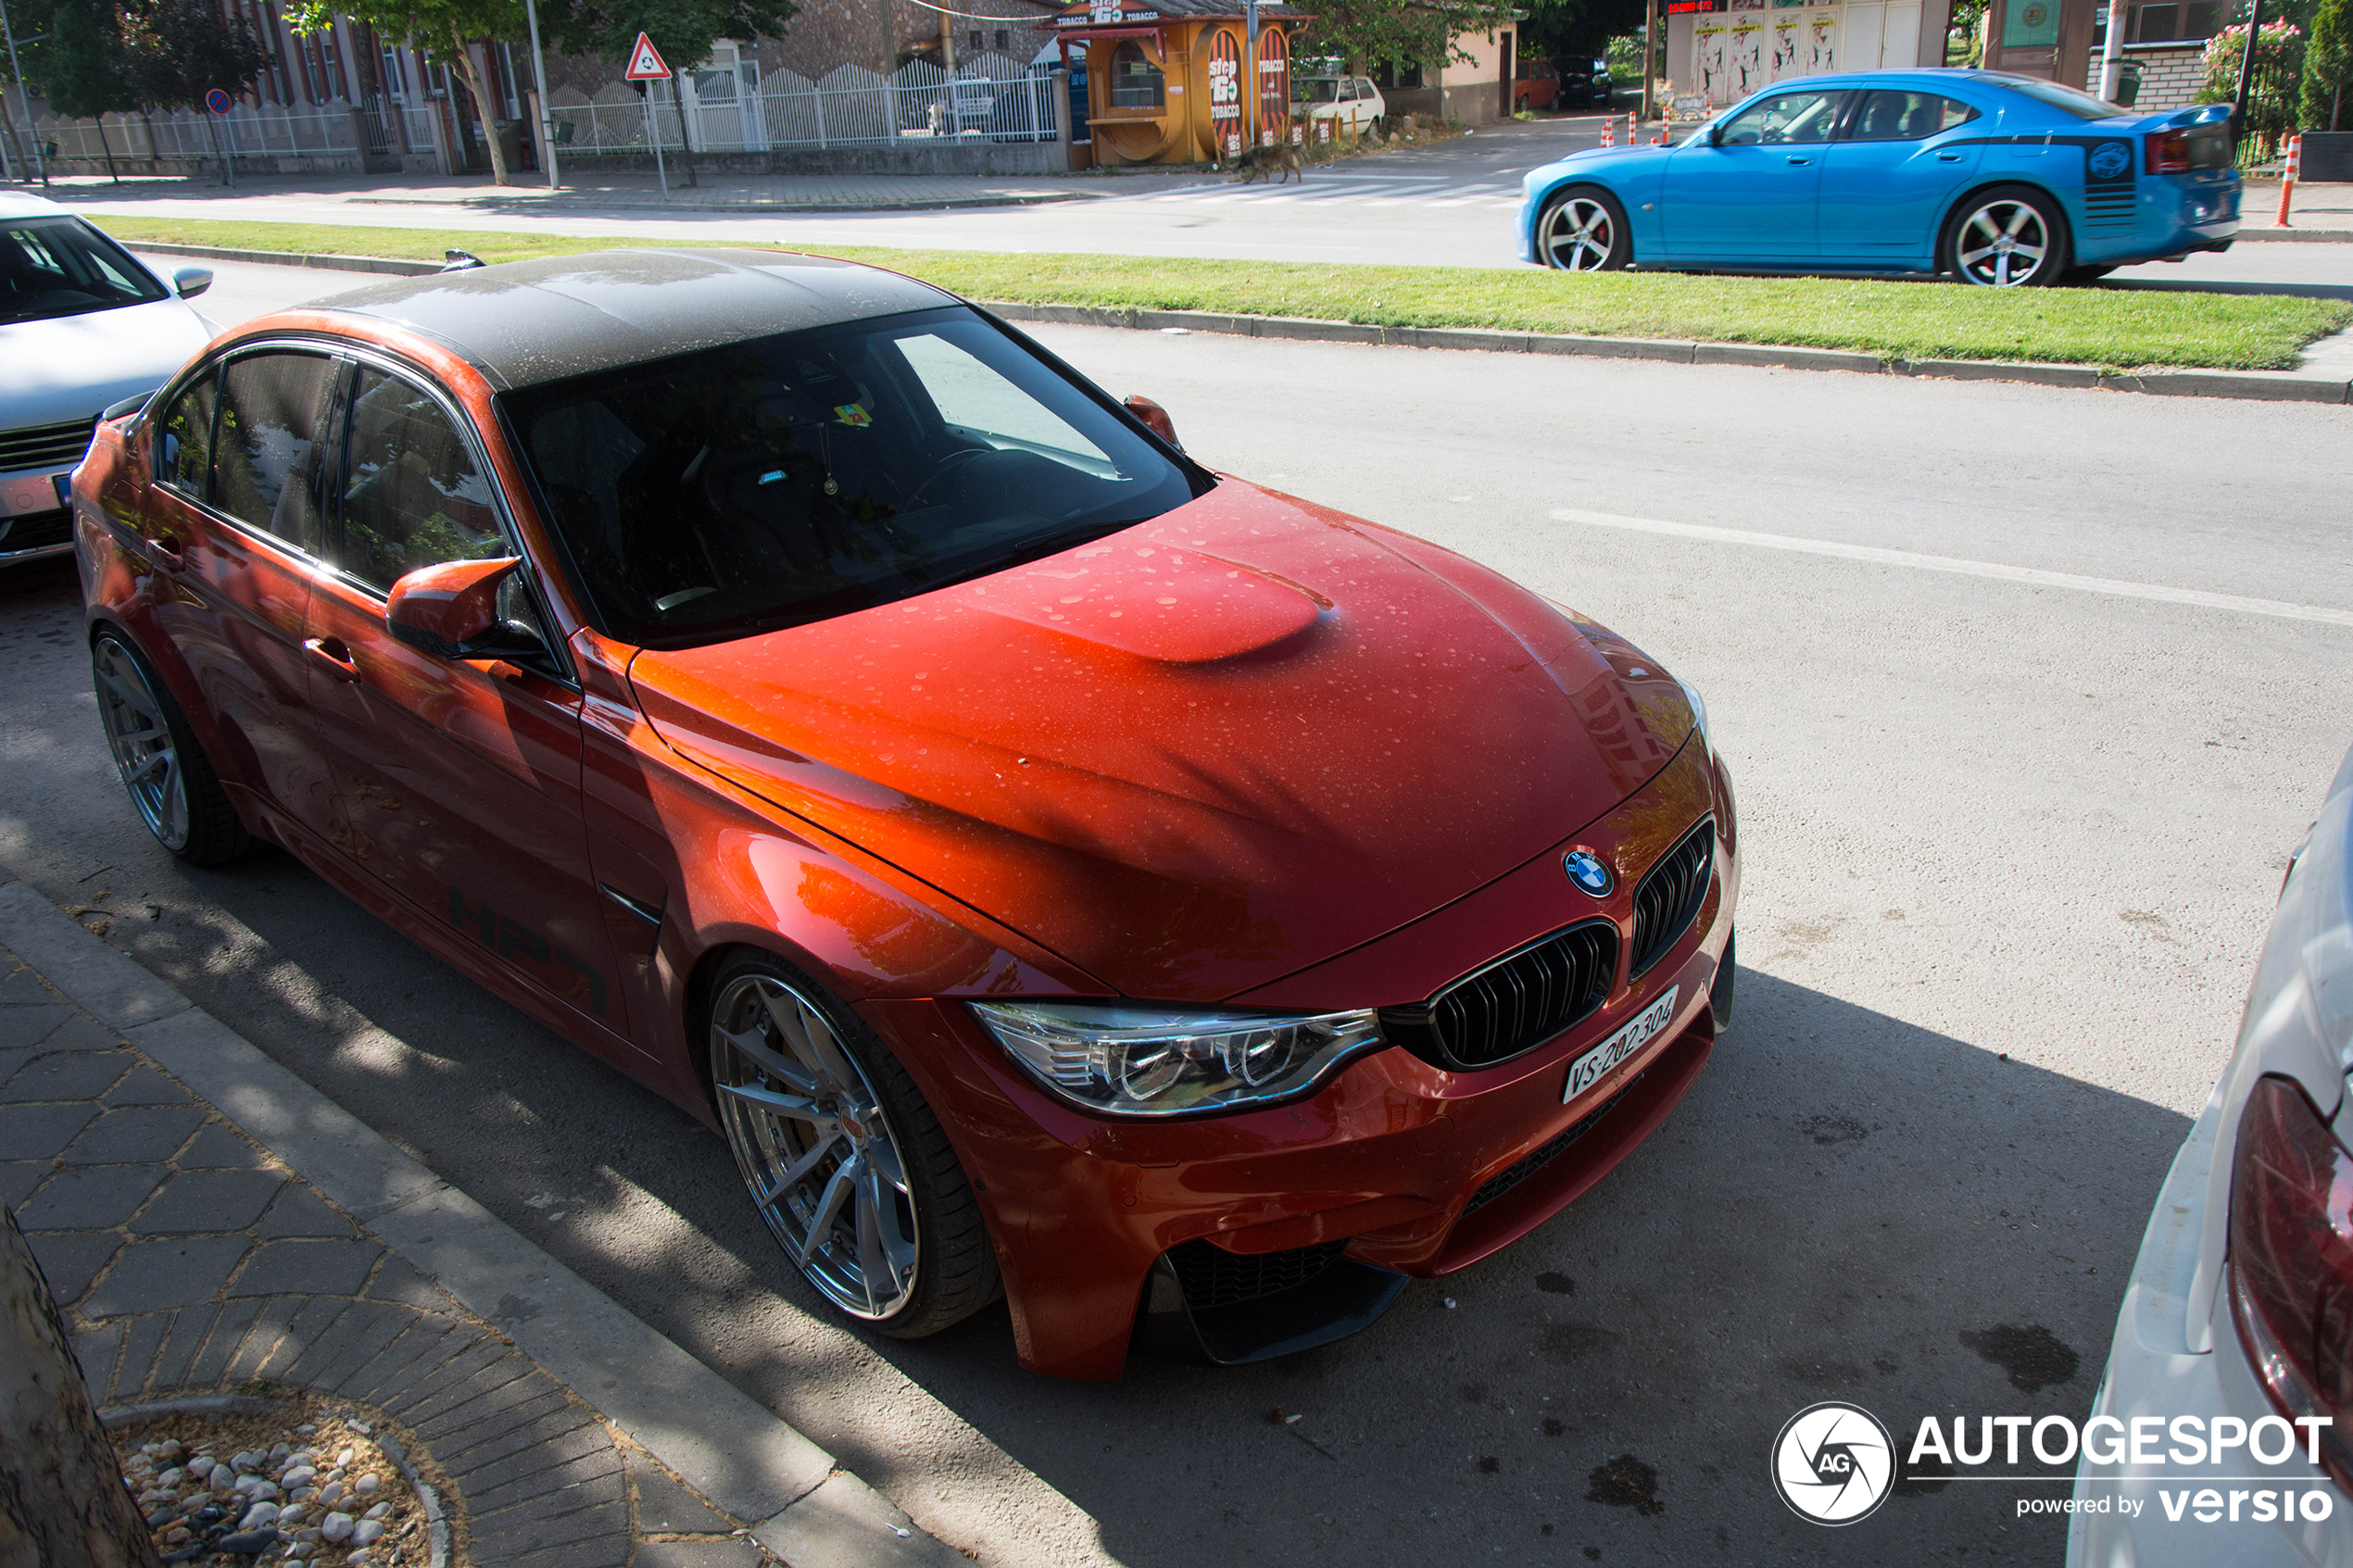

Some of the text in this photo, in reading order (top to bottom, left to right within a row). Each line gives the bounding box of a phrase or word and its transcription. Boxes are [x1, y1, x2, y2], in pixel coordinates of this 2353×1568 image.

[1057, 16, 1088, 26] TOBACCO
[1126, 11, 1159, 21] TOBACCO
[1209, 57, 1237, 79] step
[1259, 58, 1285, 73] TOBACCO
[1212, 104, 1239, 119] TOBACCO
[1567, 852, 1596, 872] BMW
